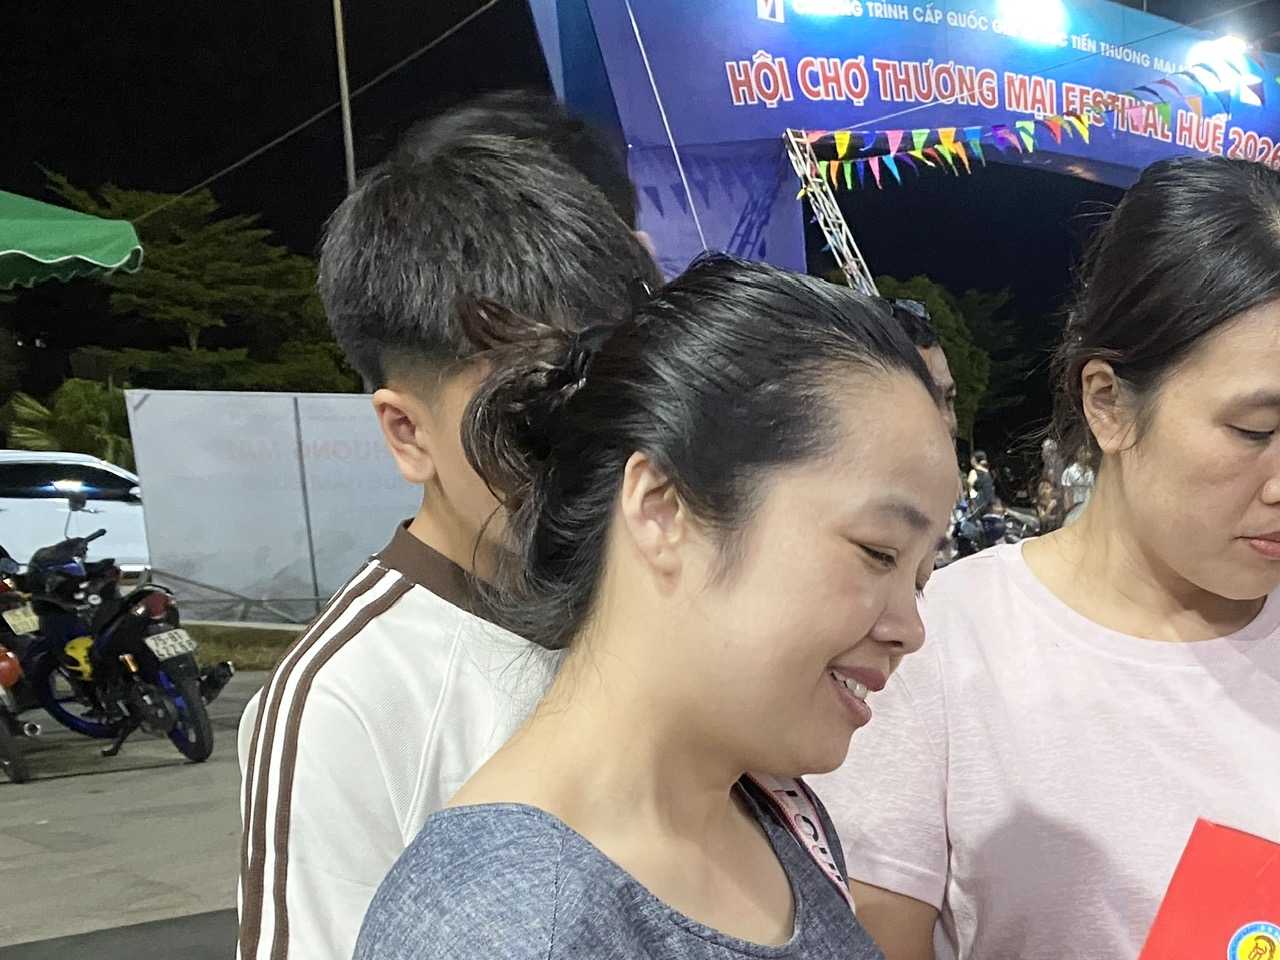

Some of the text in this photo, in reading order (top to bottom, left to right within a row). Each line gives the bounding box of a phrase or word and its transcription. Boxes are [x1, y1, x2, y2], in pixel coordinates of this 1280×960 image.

[913, 3, 942, 26] CẤP
[947, 10, 989, 32] QUỐC
[1100, 41, 1151, 67] THƯƠNG
[725, 50, 794, 108] HỘI
[797, 55, 870, 106] CHỢ
[873, 58, 998, 109] THƯƠNG
[1004, 71, 1057, 121] MẠI
